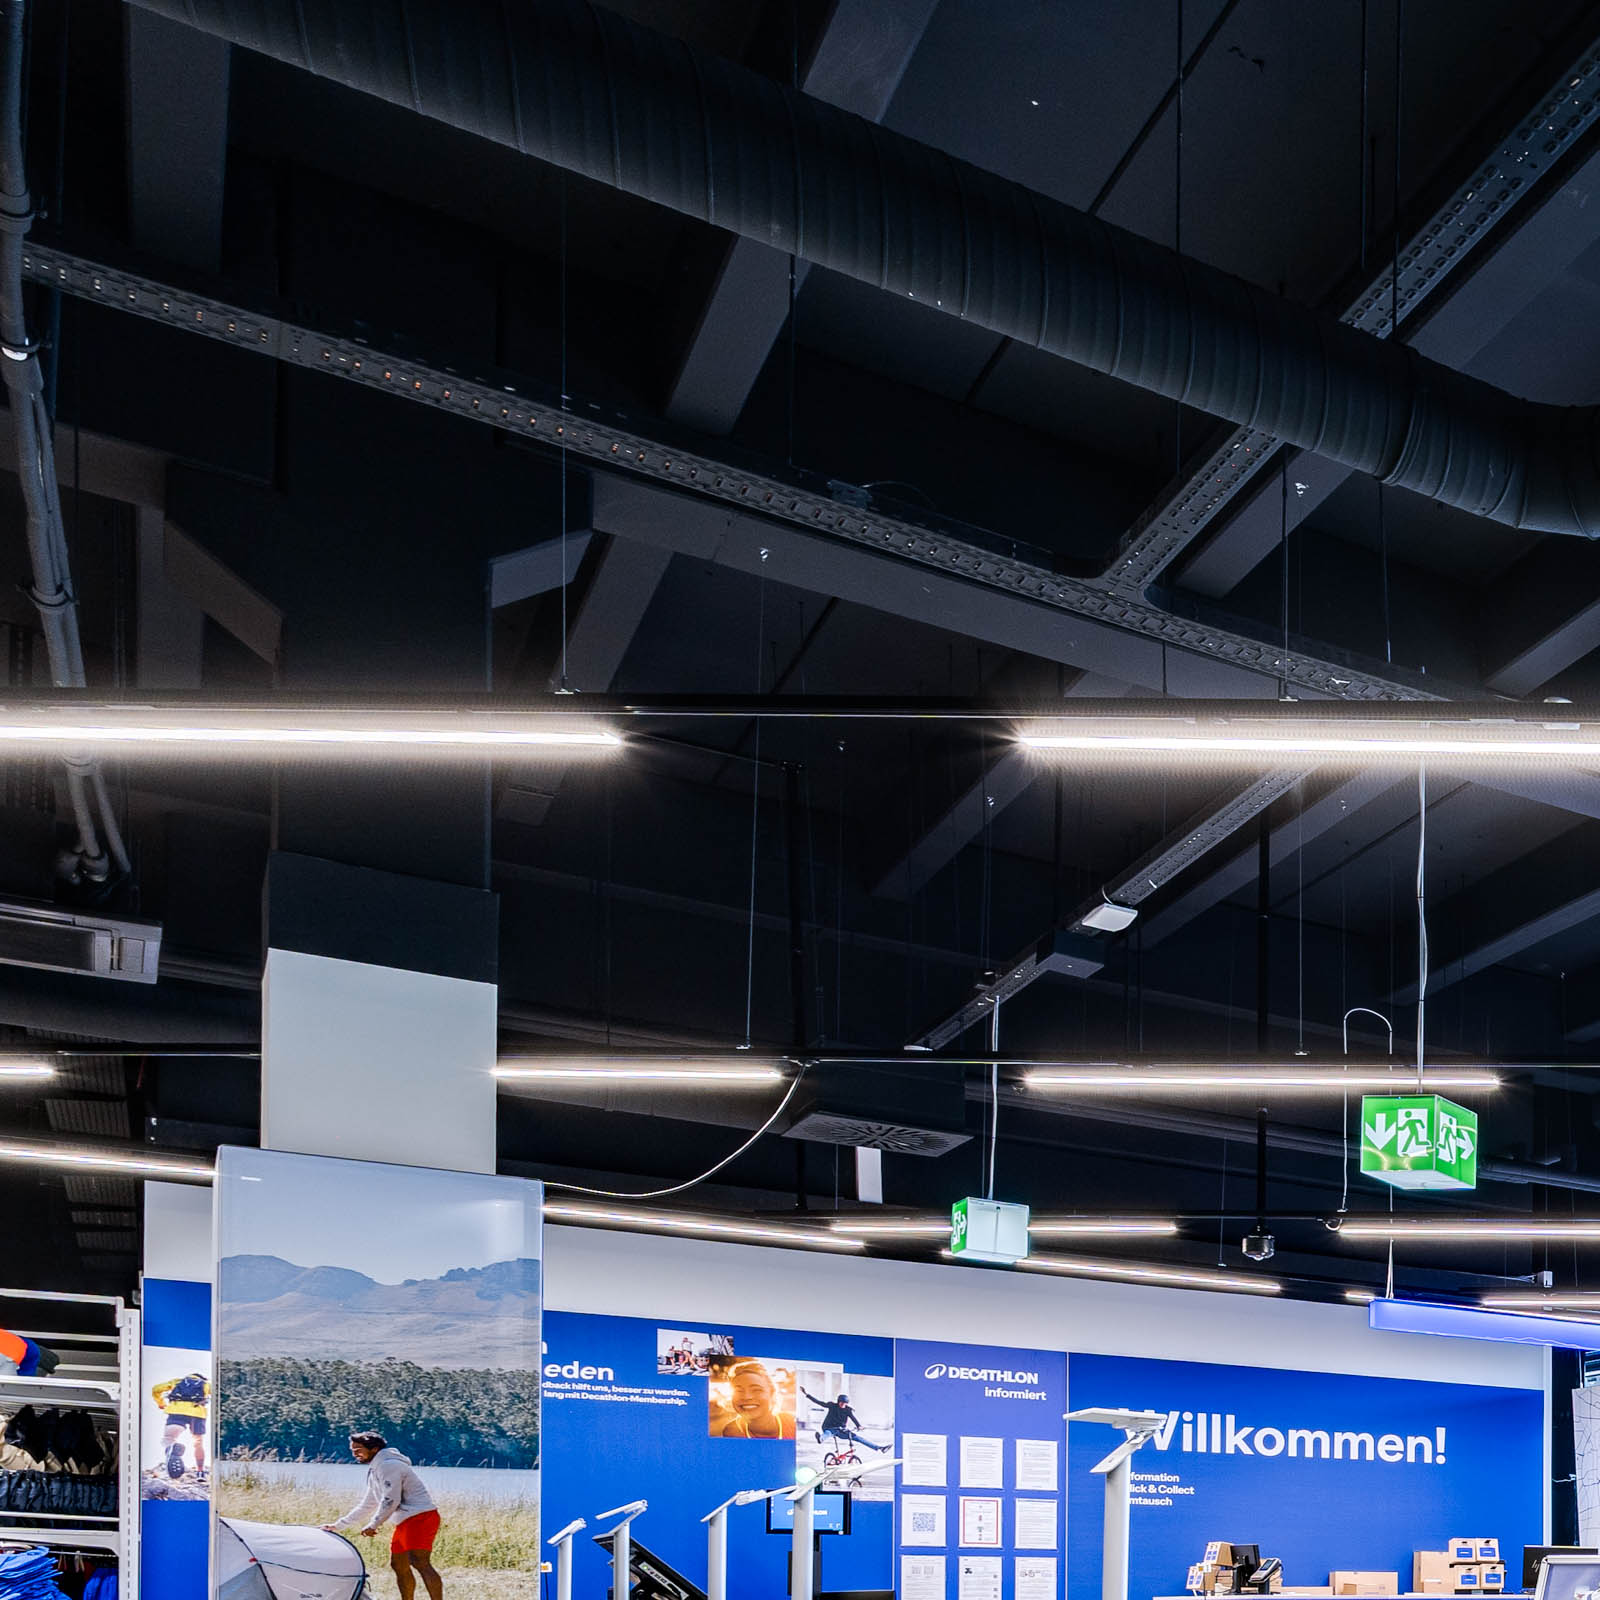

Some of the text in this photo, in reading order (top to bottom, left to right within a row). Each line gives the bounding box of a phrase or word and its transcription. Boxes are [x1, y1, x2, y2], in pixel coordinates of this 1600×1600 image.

[543, 1360, 614, 1381] eden
[947, 1366, 1039, 1385] DECATHLON
[541, 1381, 691, 1398] dback hilft uns, besser zu werden.
[984, 1386, 1047, 1401] informiert
[565, 1391, 581, 1400] mit
[582, 1391, 688, 1407] Decathlon-Membership.
[1125, 1410, 1447, 1465] Willkommen!
[1130, 1472, 1180, 1482] formation
[1129, 1484, 1195, 1495] lick & Collect
[1129, 1496, 1173, 1506] mtausch
